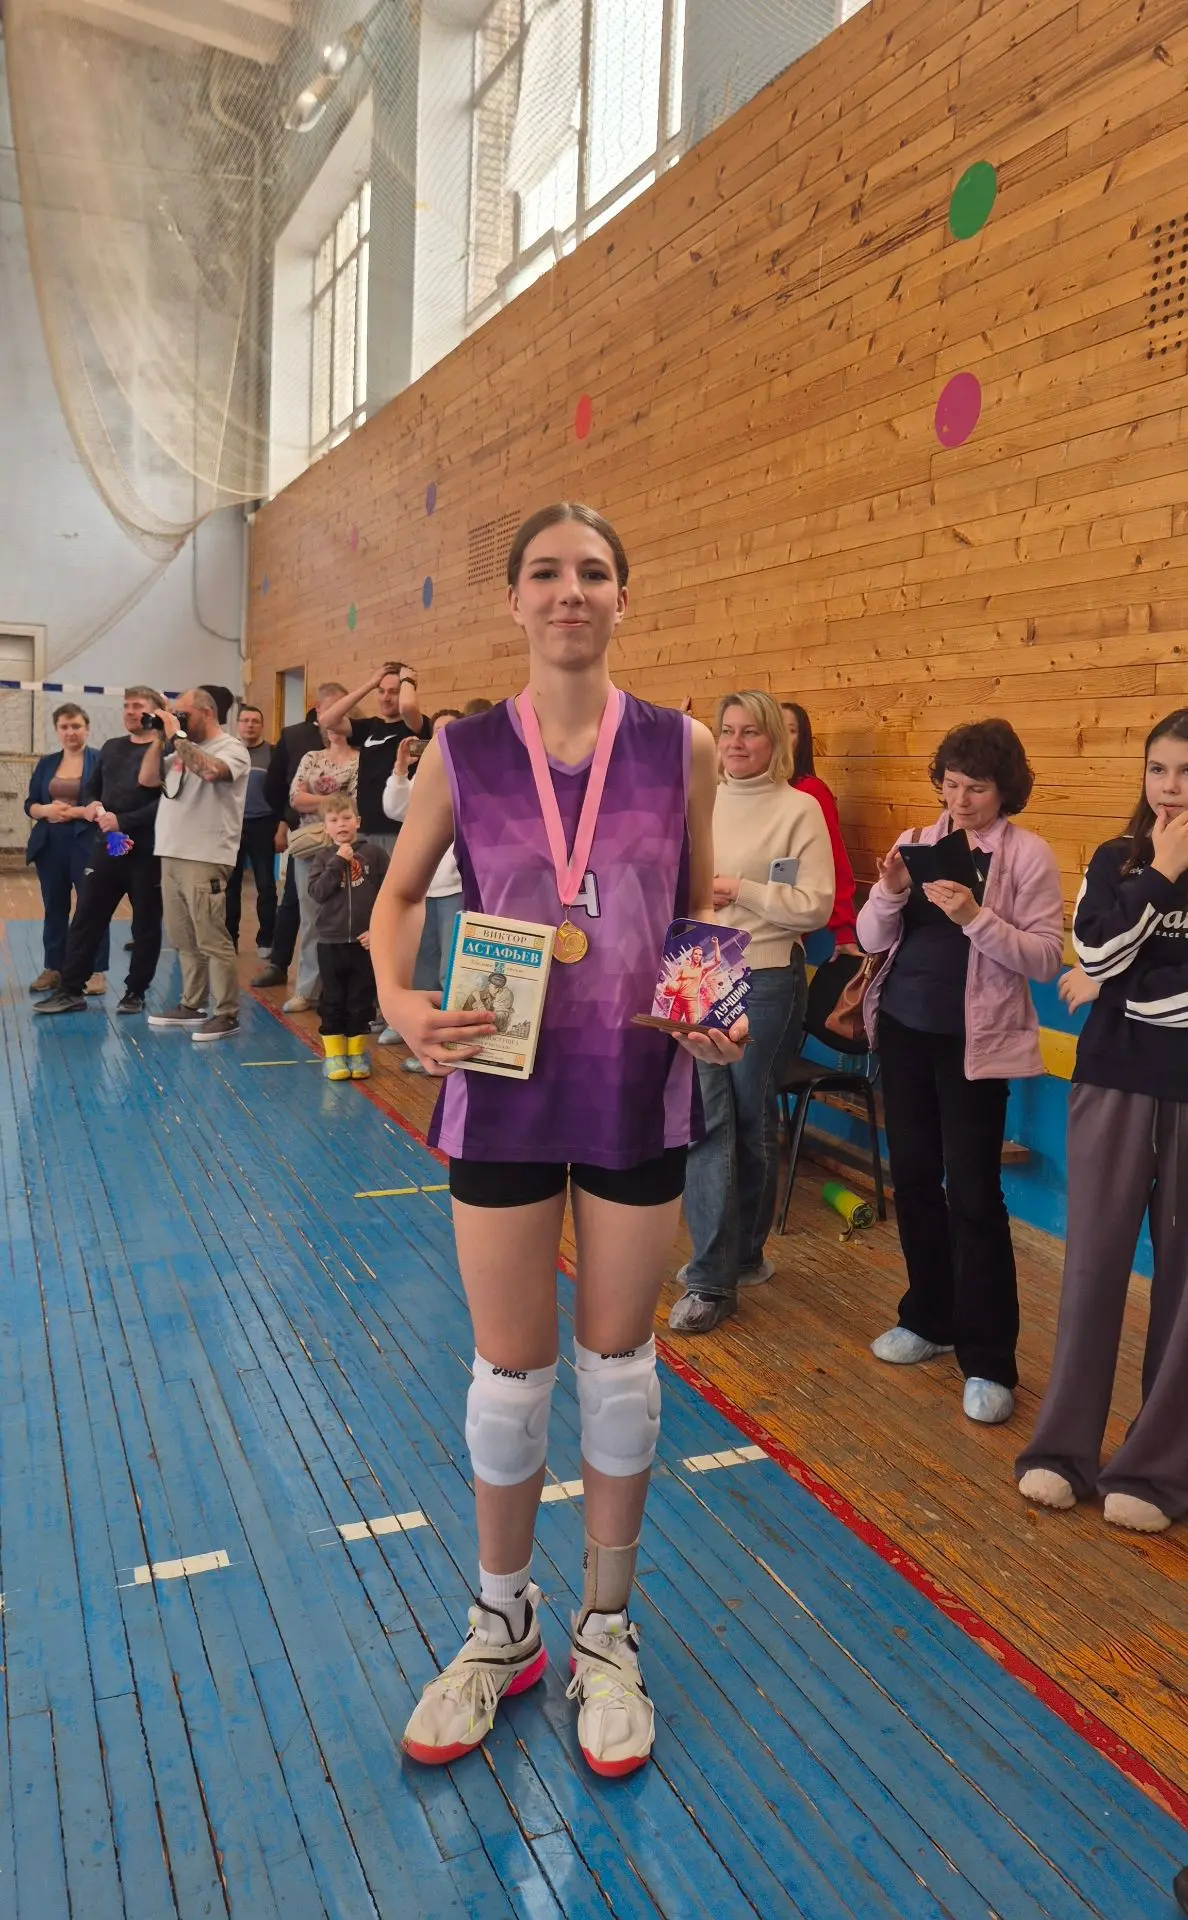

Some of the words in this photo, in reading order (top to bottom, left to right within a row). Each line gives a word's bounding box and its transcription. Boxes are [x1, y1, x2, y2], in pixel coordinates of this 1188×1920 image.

[483, 929, 527, 944] ВИКТОР
[465, 941, 540, 964] АСТАФЬЕВ
[714, 980, 750, 1020] ЛУЧШИЙ
[721, 1002, 746, 1027] ИГРОК
